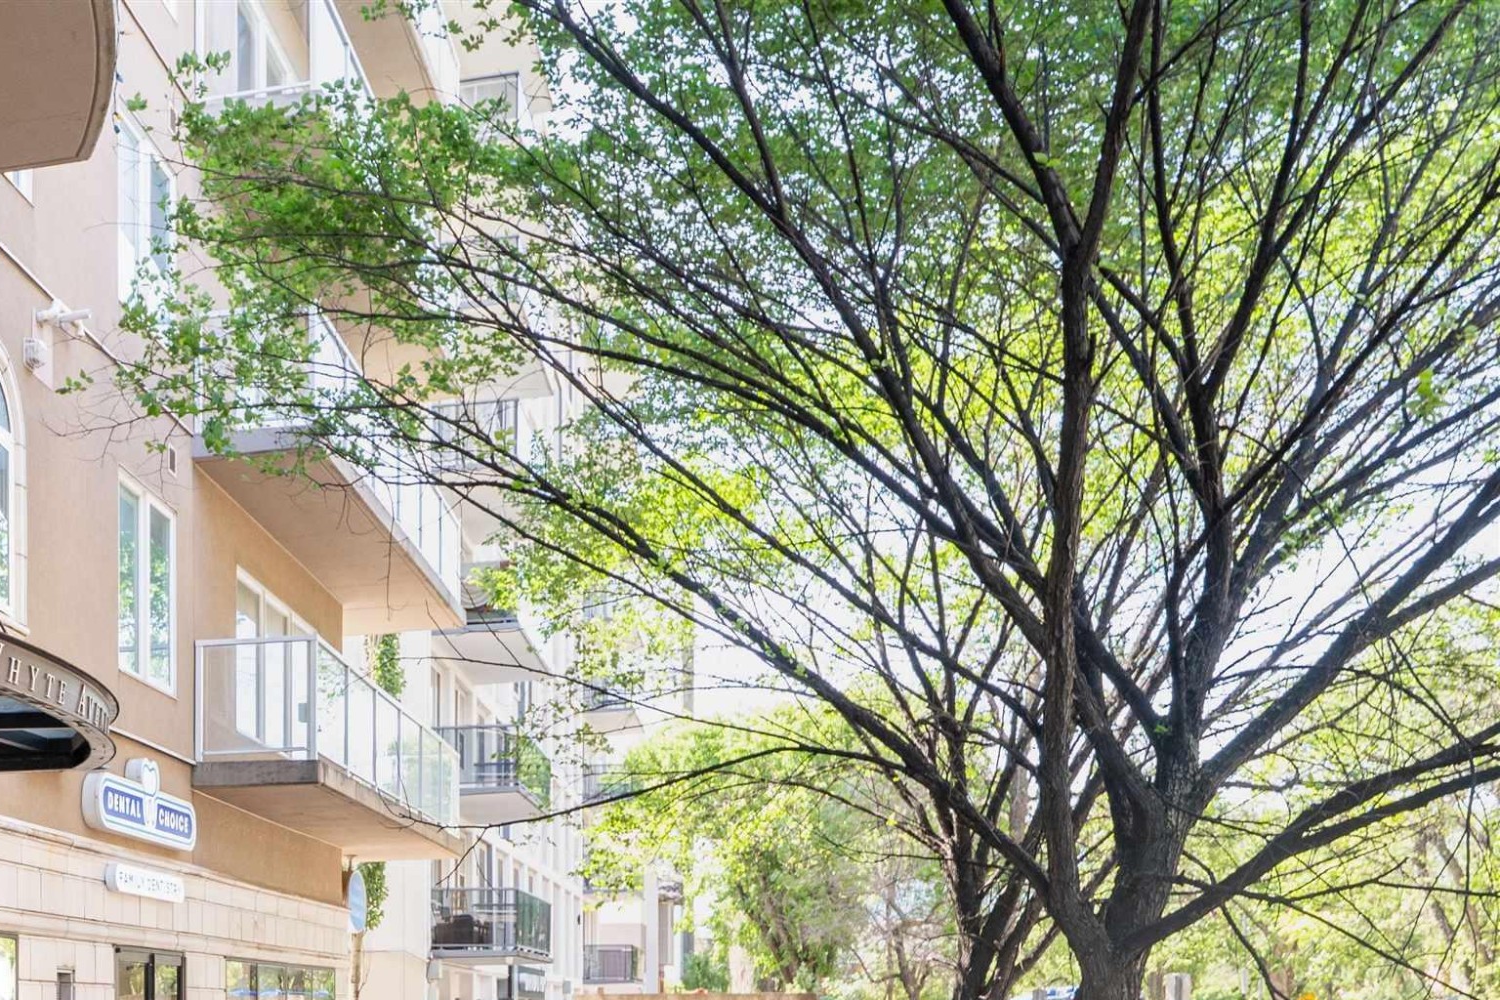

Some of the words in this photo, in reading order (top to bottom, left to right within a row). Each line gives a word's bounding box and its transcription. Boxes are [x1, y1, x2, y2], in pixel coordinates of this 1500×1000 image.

[107, 791, 142, 818] DENTAL
[158, 807, 189, 834] CHOICE
[118, 871, 147, 891] FAMLY
[147, 877, 183, 898] DENTSTRY
